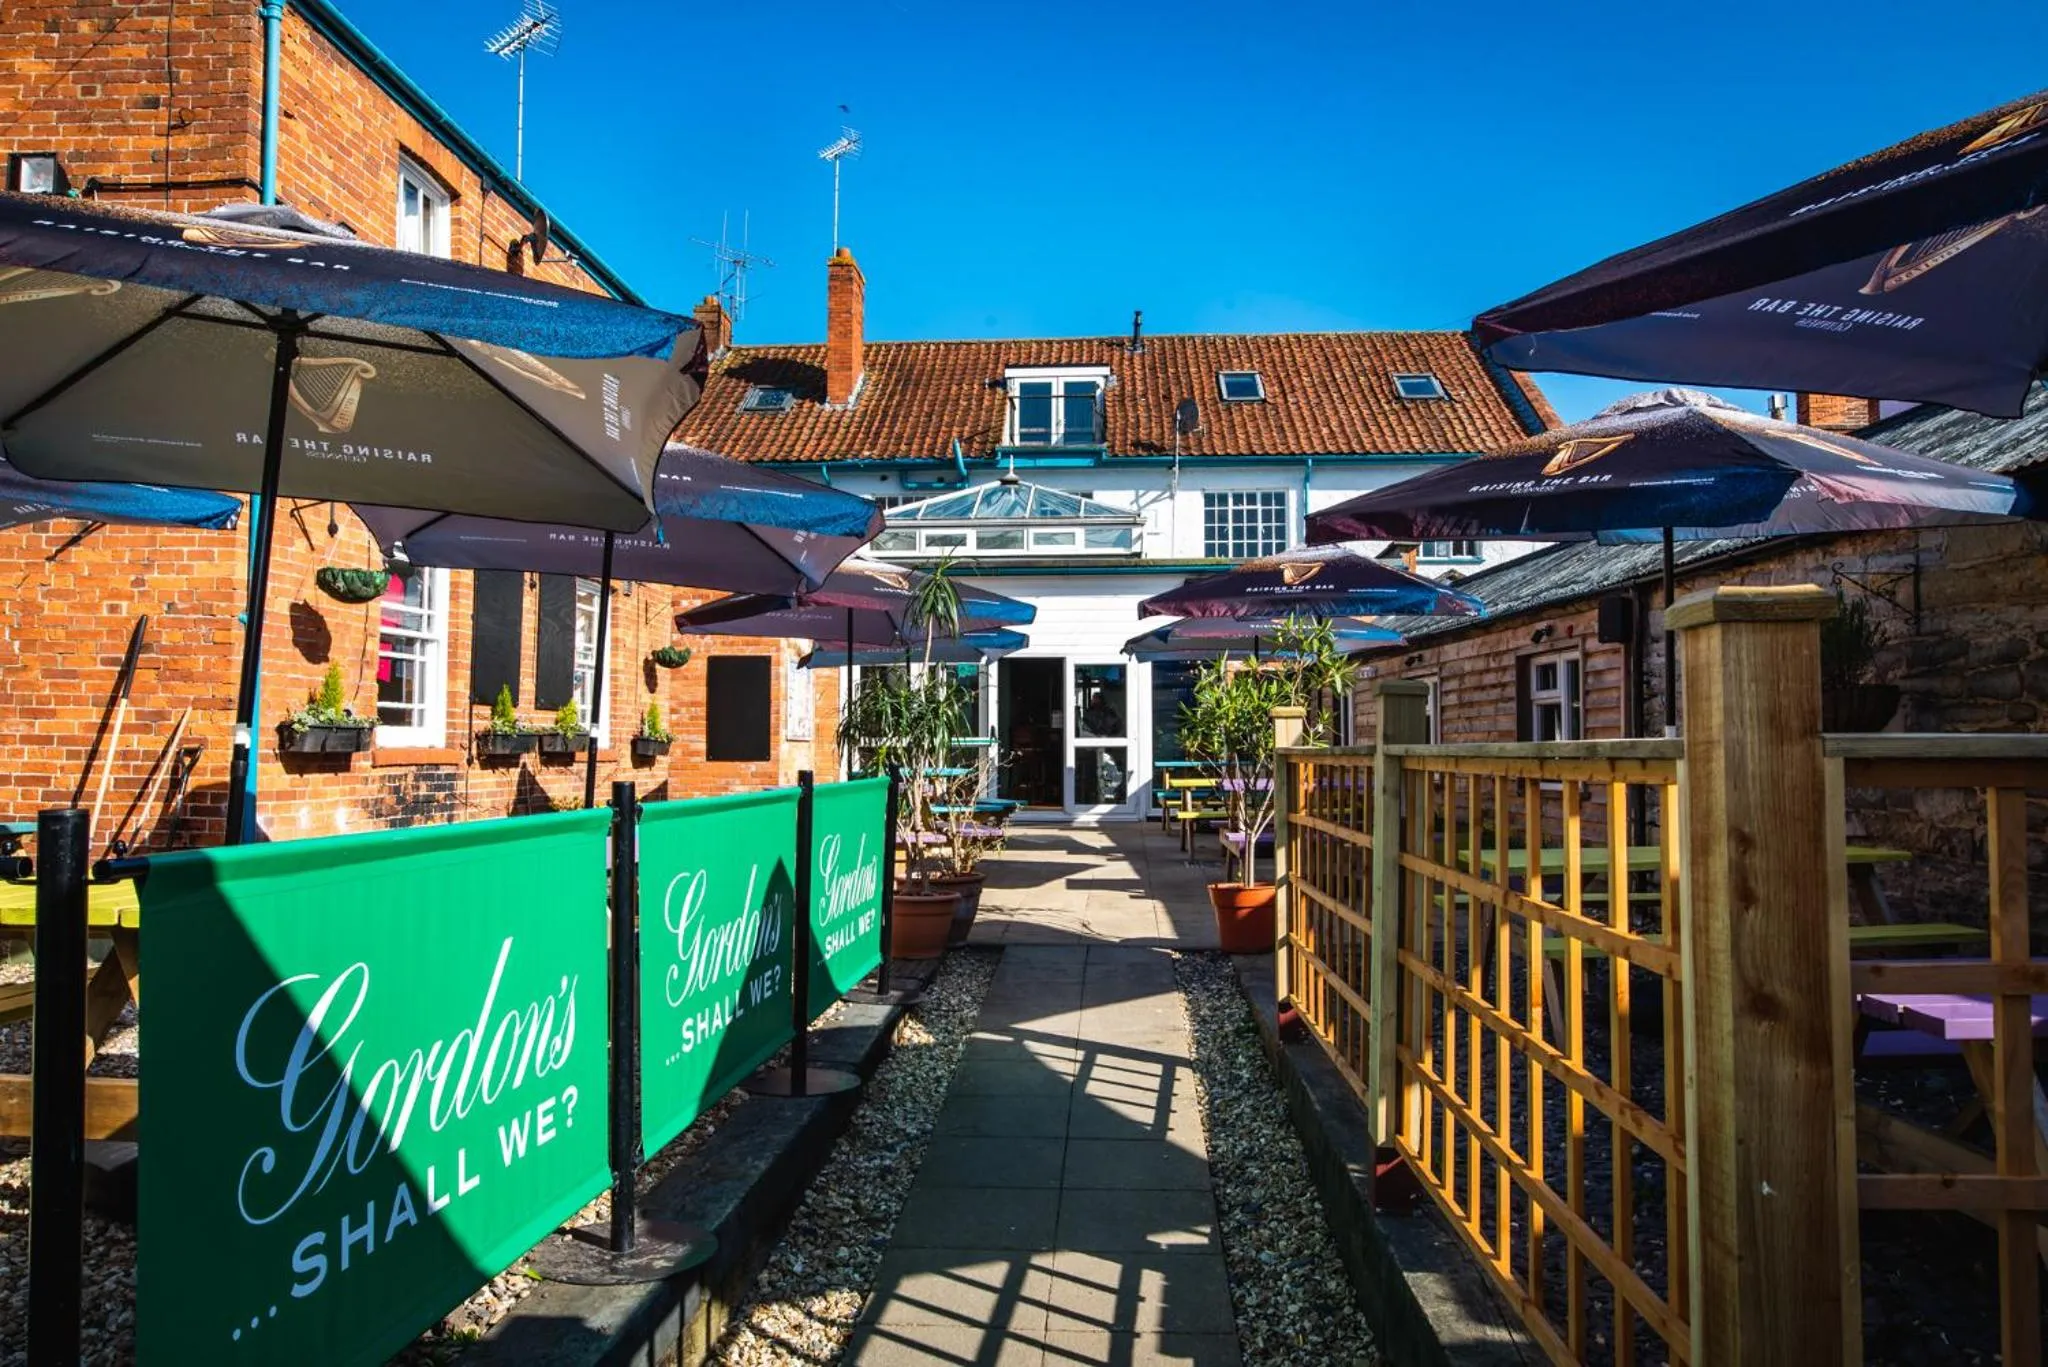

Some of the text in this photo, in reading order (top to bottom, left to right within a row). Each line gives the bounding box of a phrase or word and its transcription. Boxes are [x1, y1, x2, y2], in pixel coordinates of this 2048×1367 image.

[1469, 474, 1613, 493] RAISING THE BAR
[665, 864, 784, 1007] Gordon's
[858, 908, 876, 938] WE?
[749, 965, 782, 1007] WE?
[235, 936, 579, 1225] Gordon's
[497, 1085, 579, 1169] WE?
